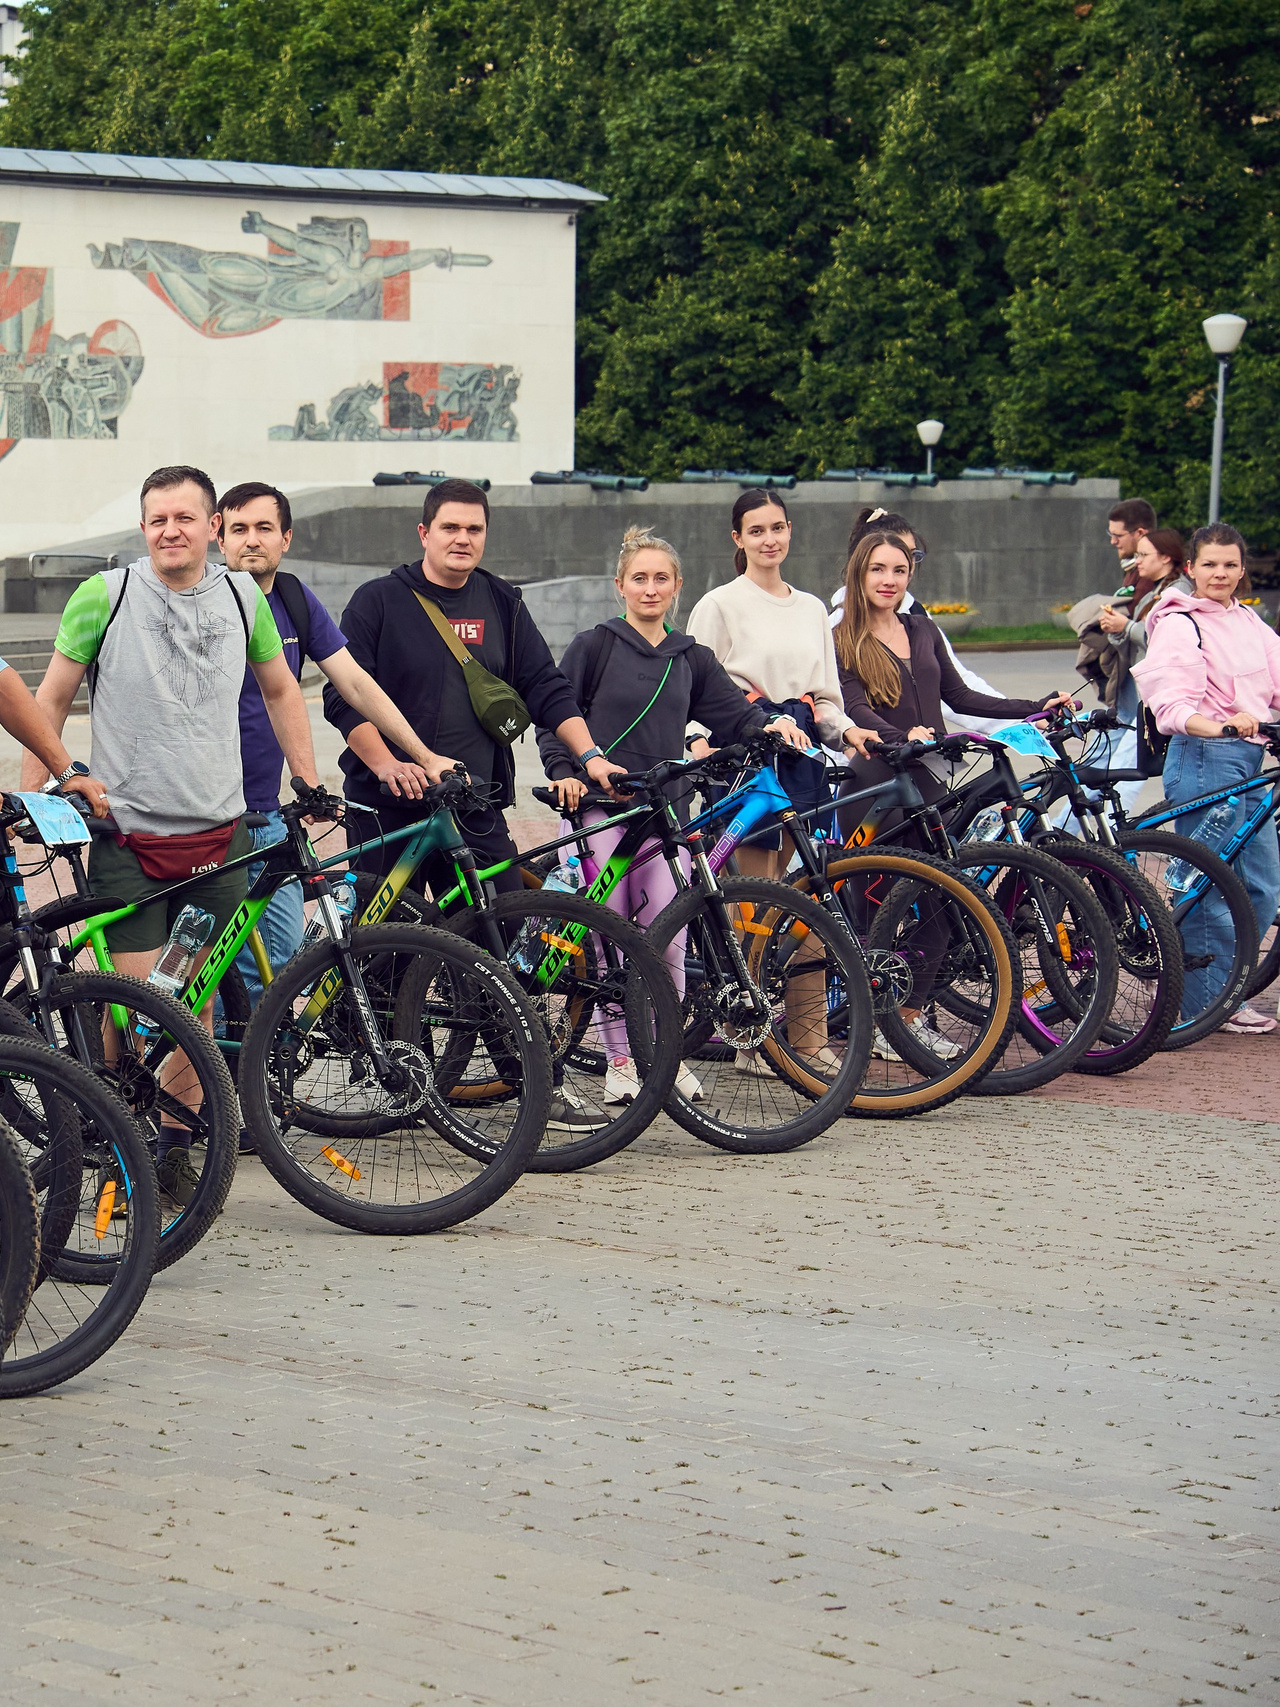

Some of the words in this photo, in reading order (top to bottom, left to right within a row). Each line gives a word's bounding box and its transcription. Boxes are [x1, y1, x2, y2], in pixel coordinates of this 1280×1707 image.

[400, 901, 423, 917] FRING
[185, 903, 250, 1010] UESSO
[474, 961, 492, 975] CST
[490, 975, 517, 1005] FRINGE
[514, 1005, 528, 1028] 2.10
[1223, 965, 1250, 1009] STELS
[449, 1125, 479, 1148] FRINGE
[702, 1120, 730, 1138] FRINGE
[729, 1130, 747, 1140] CST
[479, 1145, 497, 1155] CST
